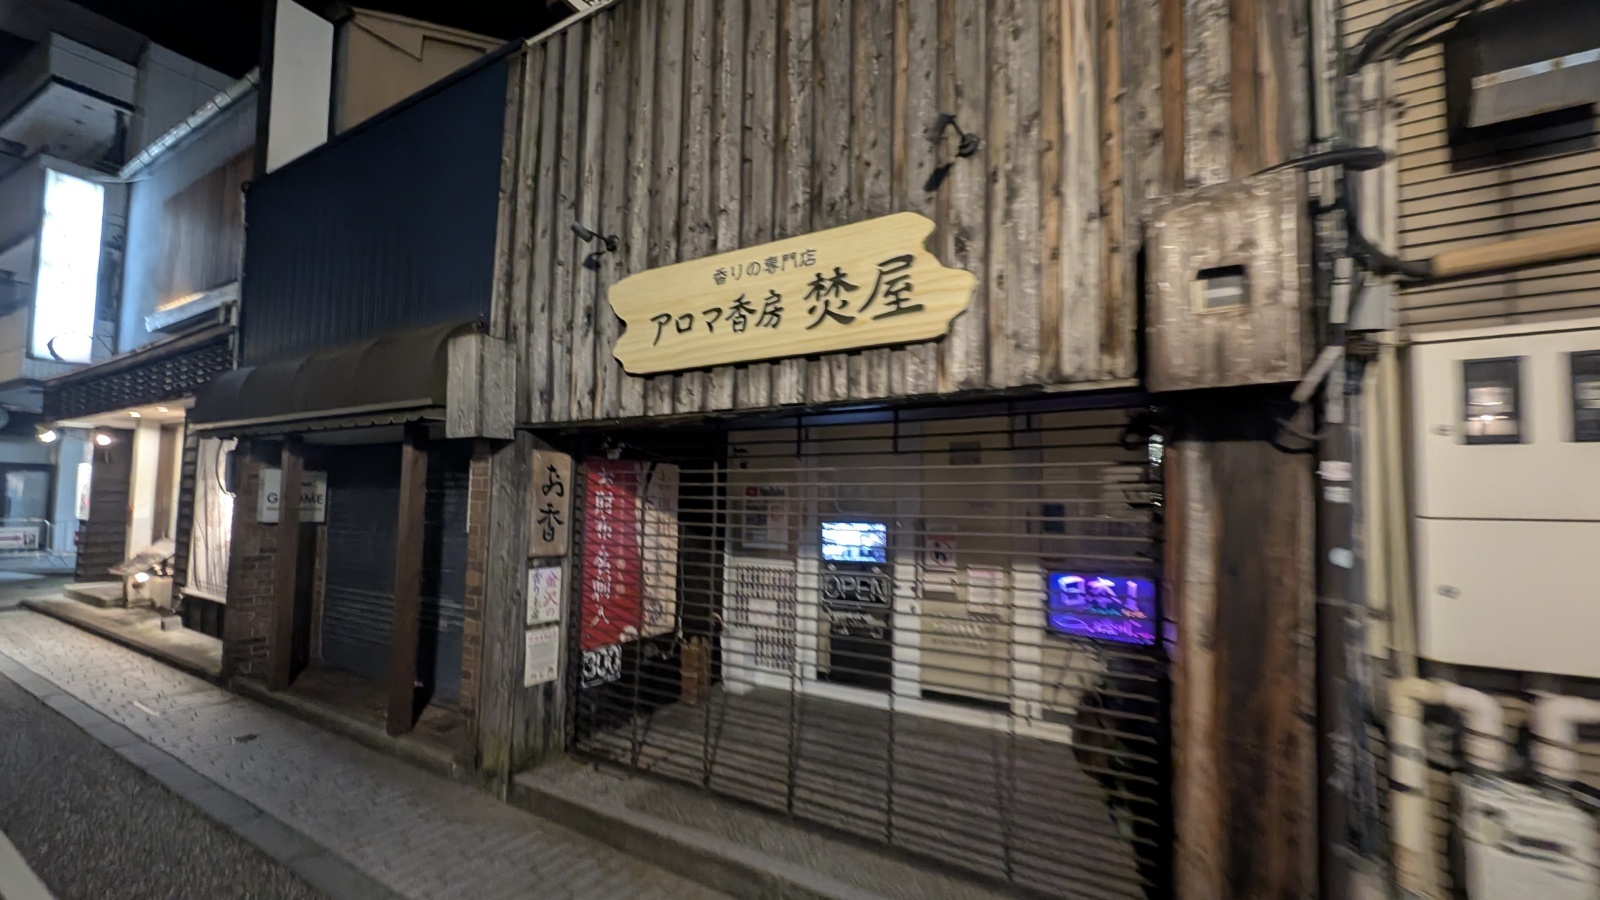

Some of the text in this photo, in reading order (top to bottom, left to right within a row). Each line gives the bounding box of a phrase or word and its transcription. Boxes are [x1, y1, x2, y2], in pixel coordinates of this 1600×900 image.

[712, 248, 818, 286] 香りの専門店
[650, 253, 925, 347] アロマ香房 焚屋
[537, 464, 565, 543] お香
[823, 574, 888, 604] OPEN
